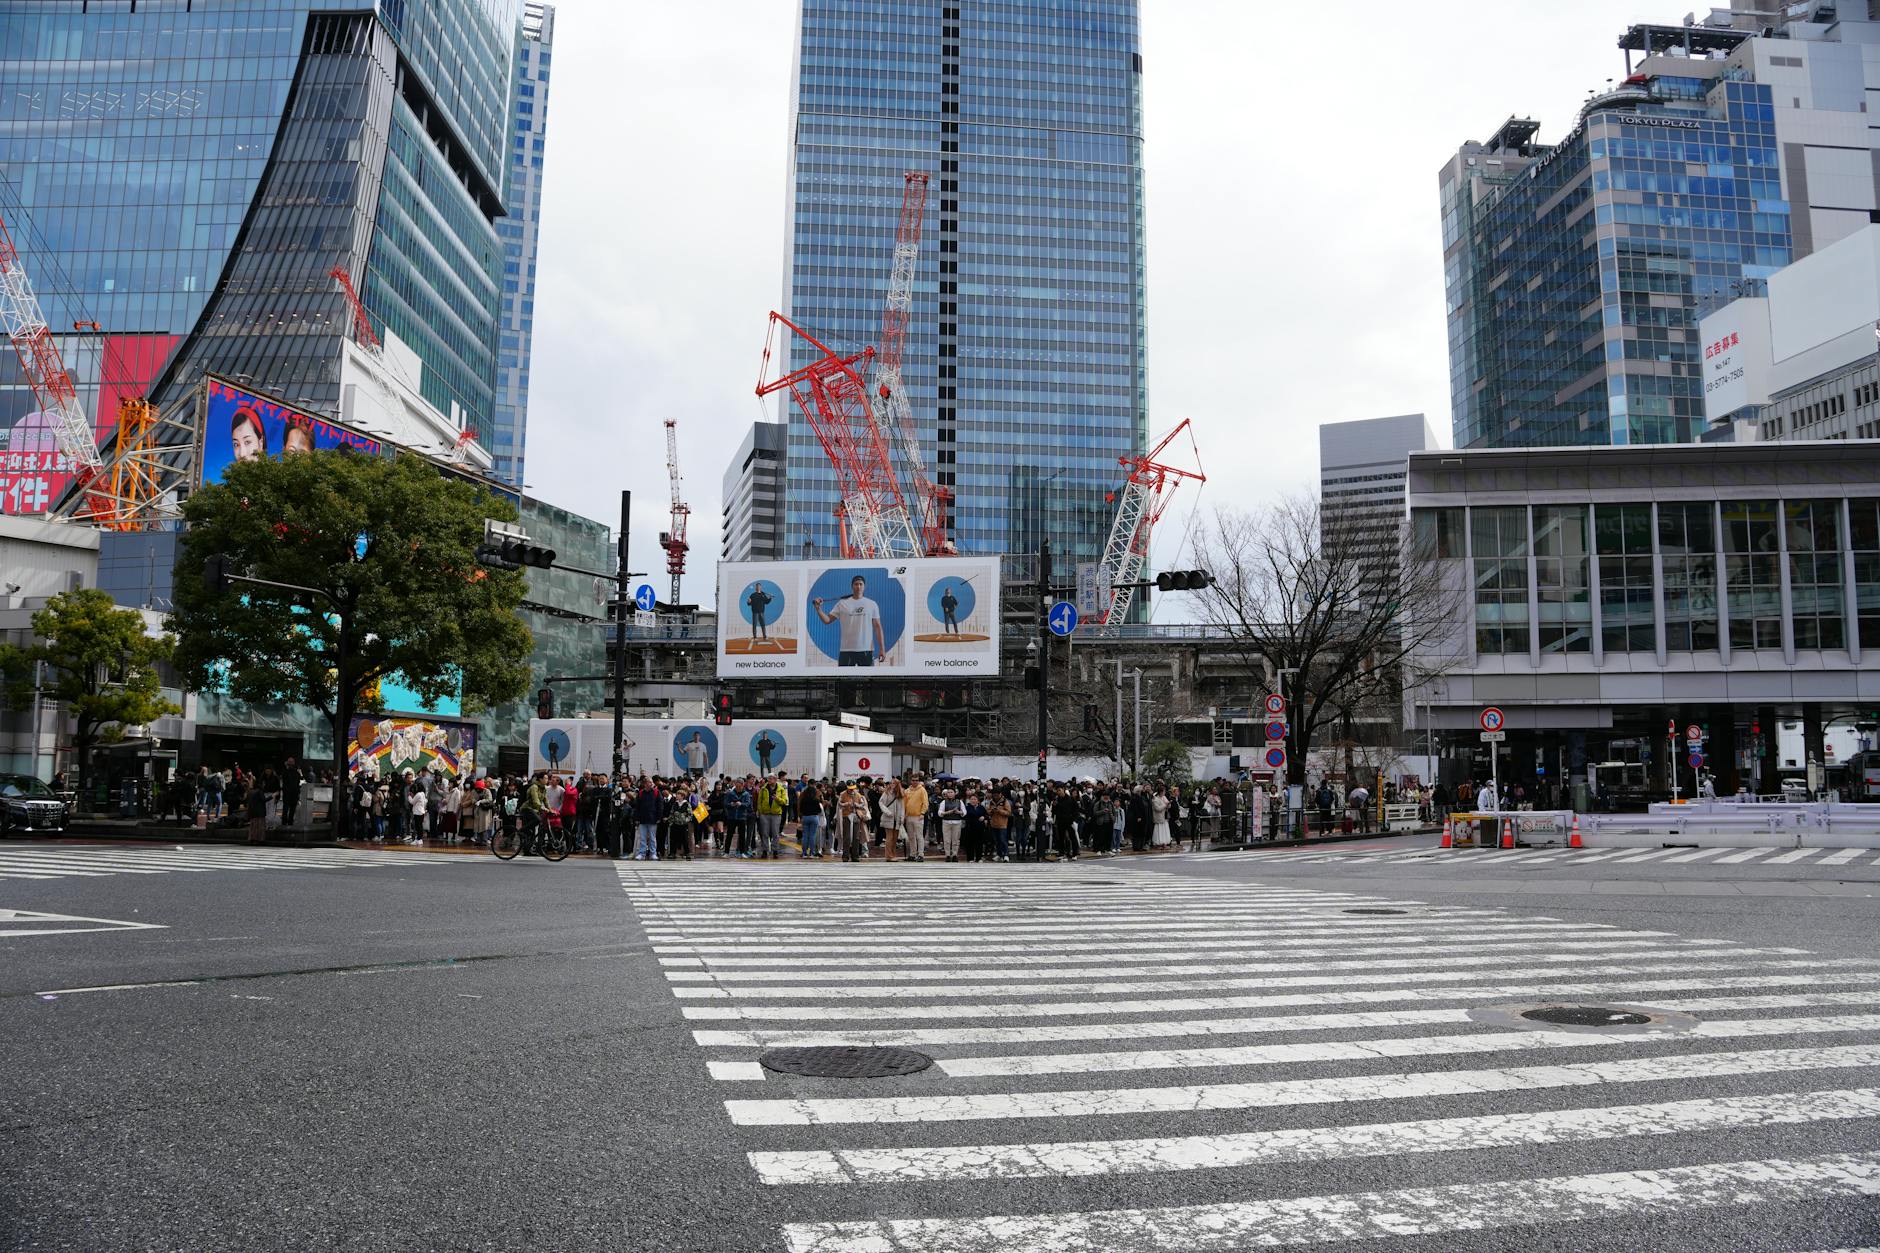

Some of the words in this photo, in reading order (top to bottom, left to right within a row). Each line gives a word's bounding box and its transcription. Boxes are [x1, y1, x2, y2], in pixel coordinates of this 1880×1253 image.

[1620, 116, 1658, 126] TOKYU
[1662, 119, 1701, 129] PLAZA
[1538, 126, 1582, 171] FUKURAS
[1706, 331, 1740, 360] 広告募集
[1085, 567, 1095, 611] 渋谷駅前
[753, 660, 786, 668] balance
[943, 659, 979, 667] balance
